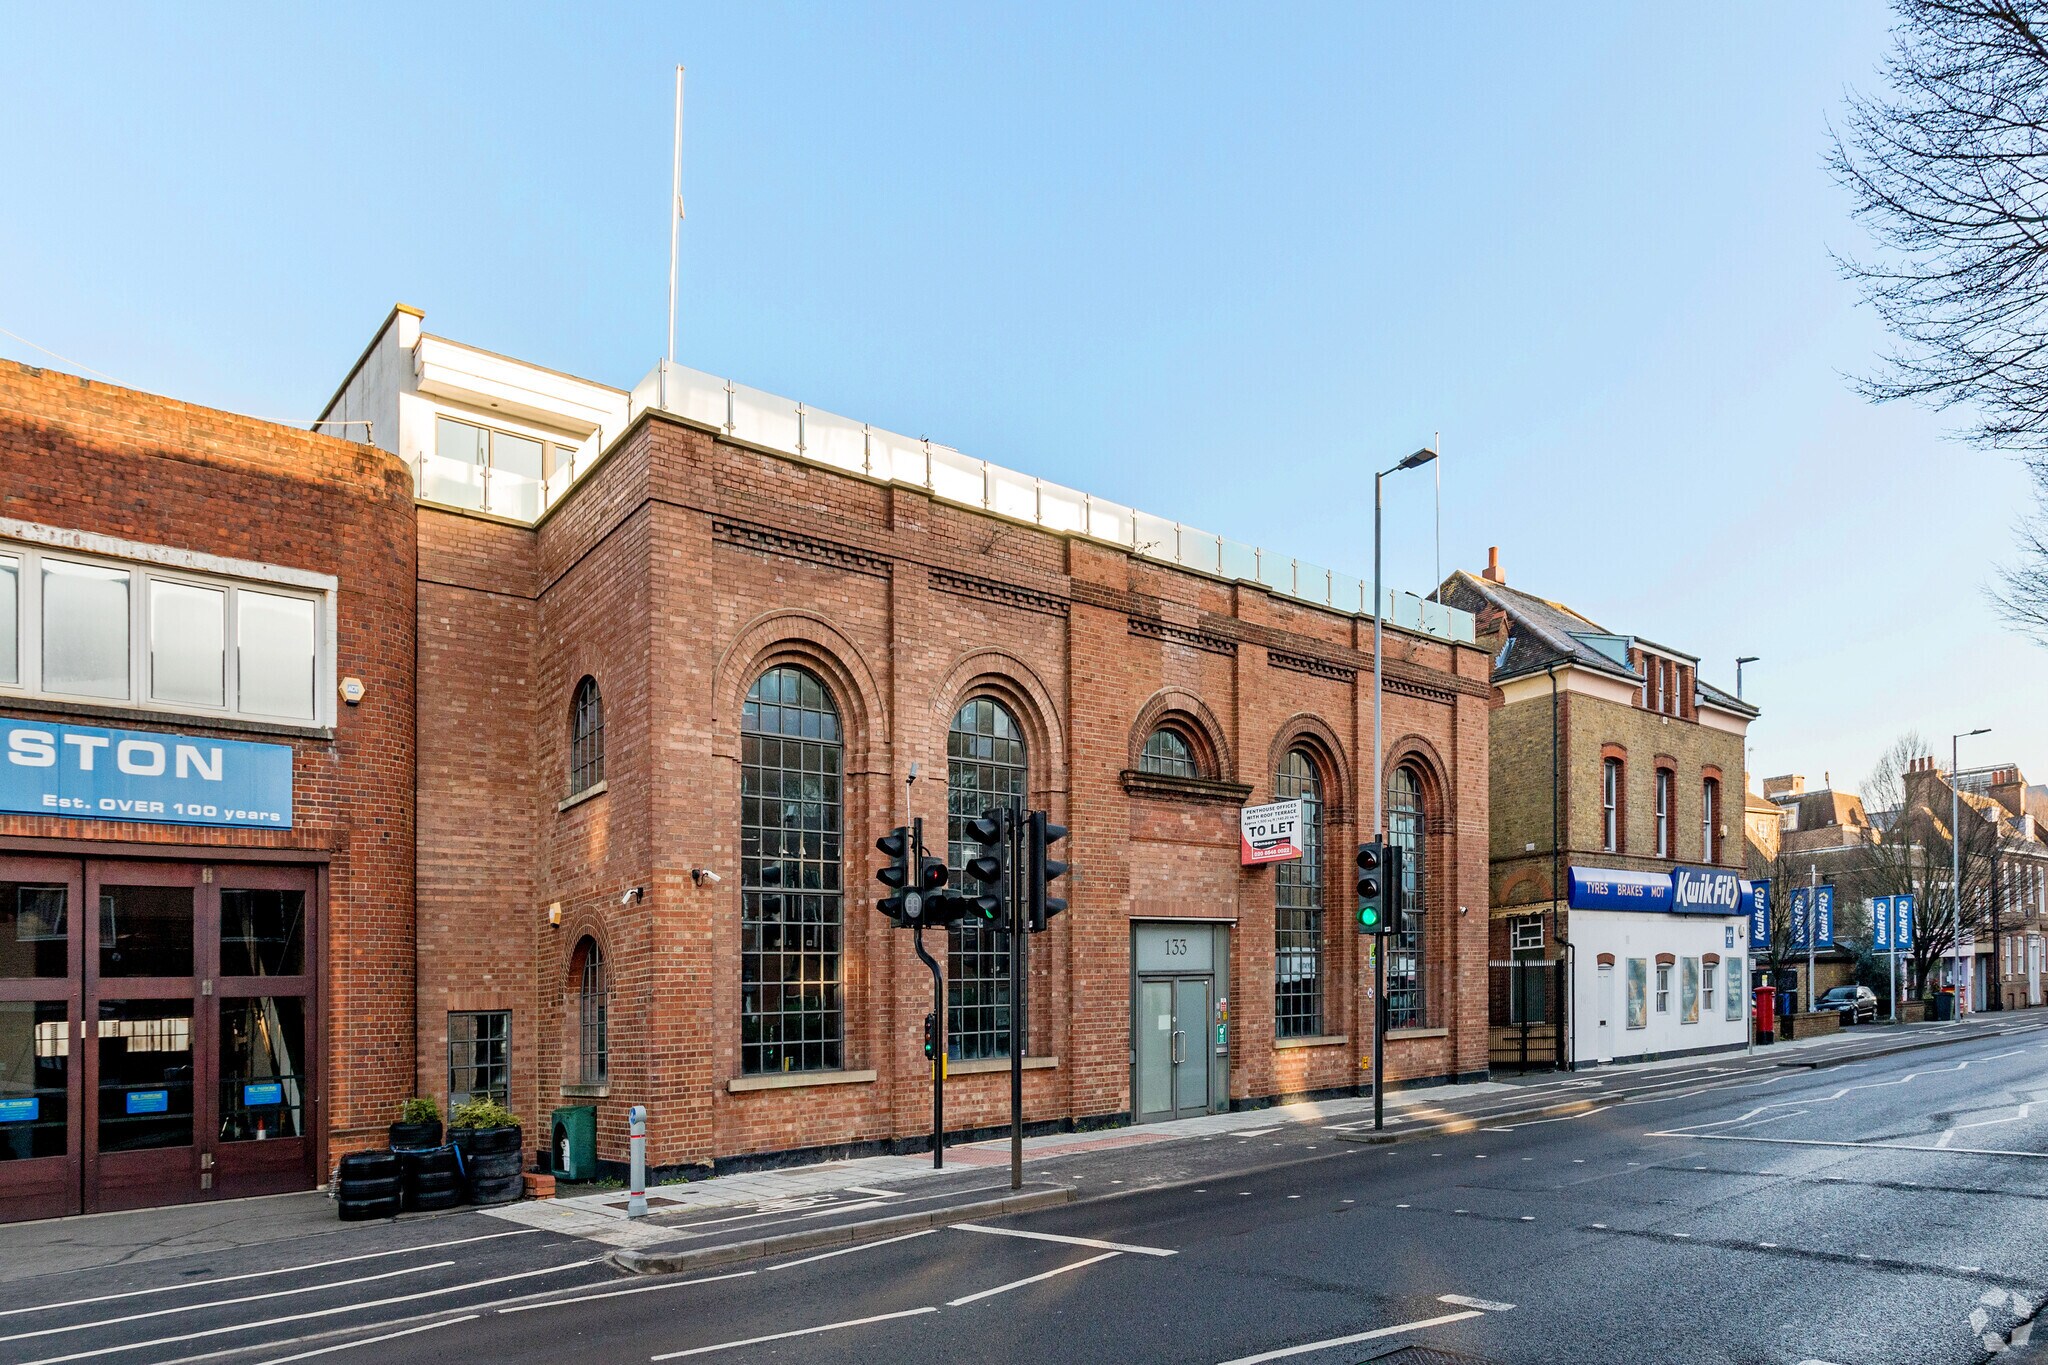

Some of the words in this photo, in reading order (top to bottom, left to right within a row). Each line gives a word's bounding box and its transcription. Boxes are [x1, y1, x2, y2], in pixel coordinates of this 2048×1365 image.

[8, 728, 223, 781] STON
[42, 794, 92, 809] Est.
[99, 798, 164, 813] OVER
[173, 802, 217, 817] 100
[224, 808, 281, 821] years
[1249, 825, 1266, 837] TO
[1271, 821, 1294, 834] LET
[1586, 881, 1609, 895] TYRES
[1617, 884, 1643, 897] BRAKES
[1651, 886, 1665, 898] MOT
[1165, 939, 1188, 956] 133
